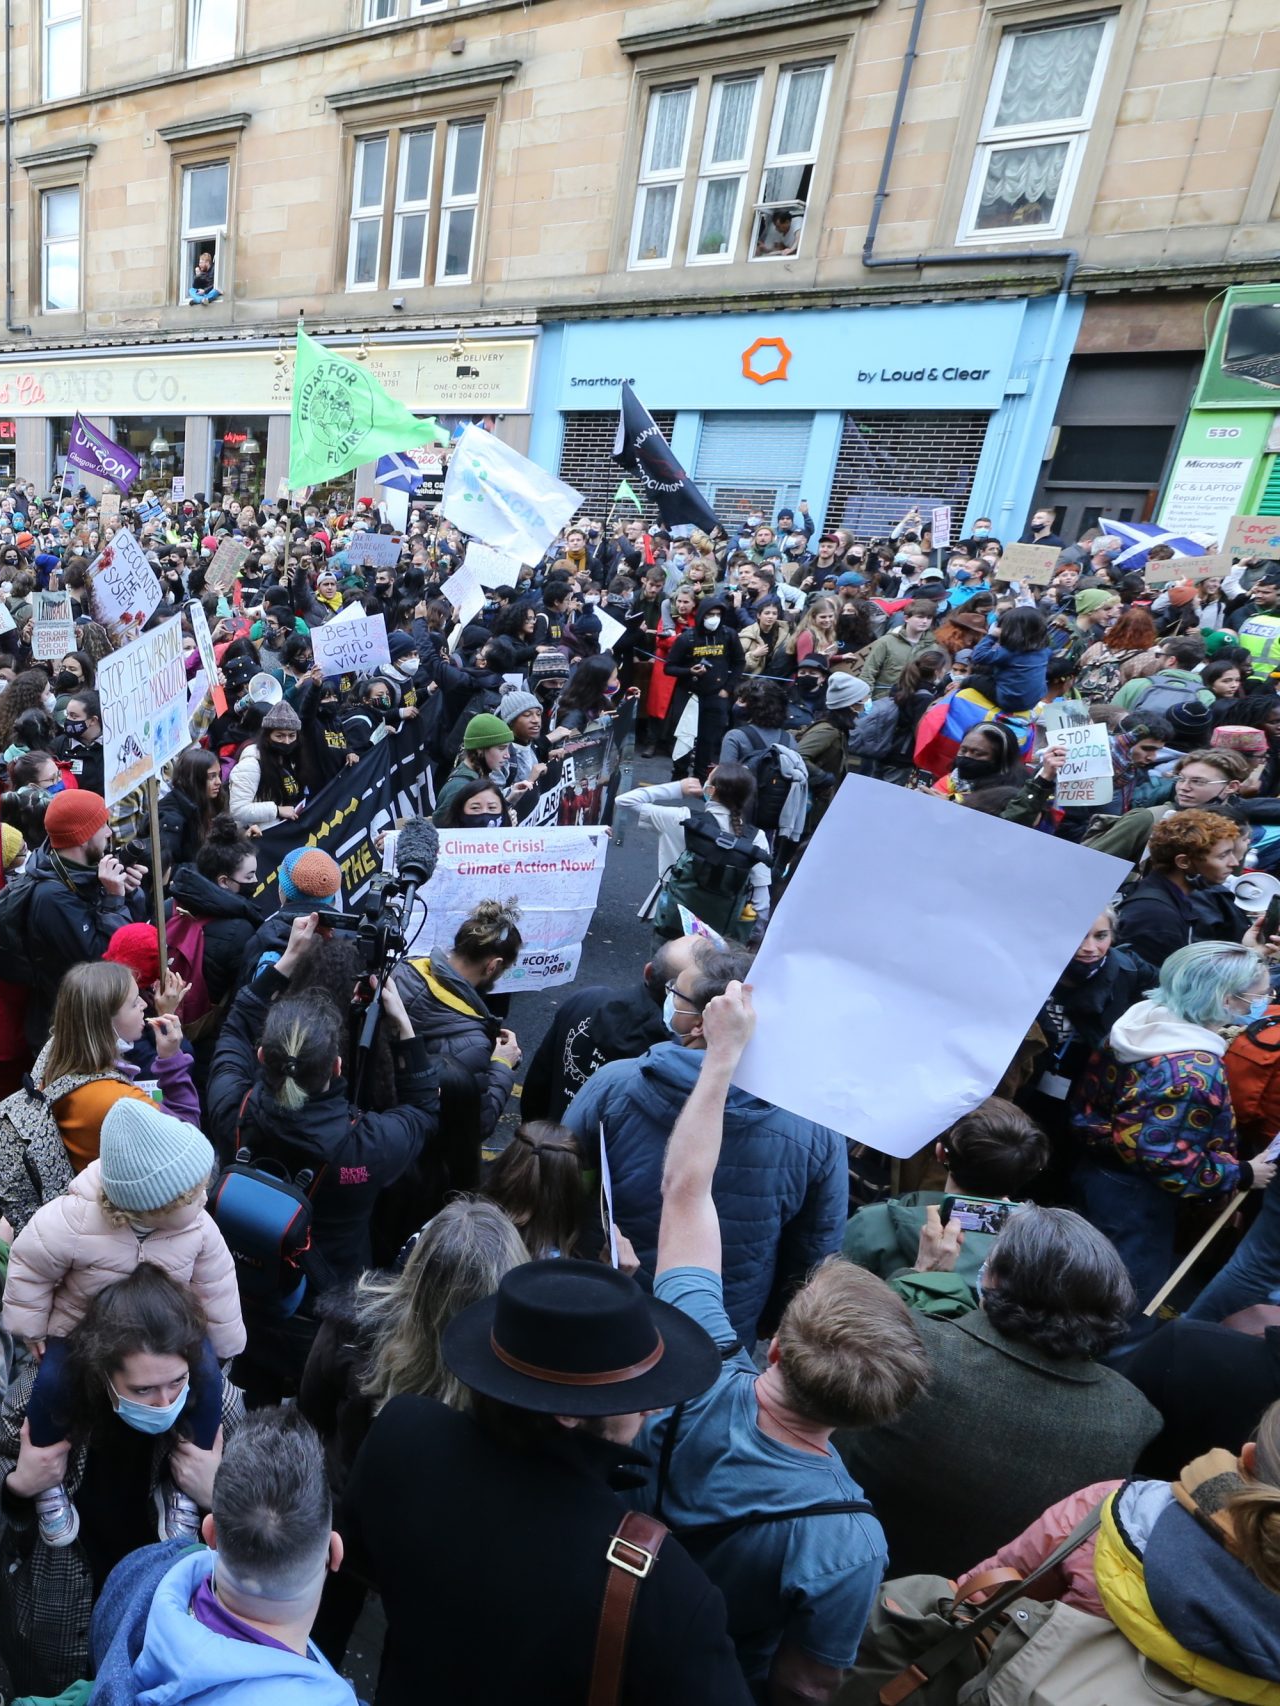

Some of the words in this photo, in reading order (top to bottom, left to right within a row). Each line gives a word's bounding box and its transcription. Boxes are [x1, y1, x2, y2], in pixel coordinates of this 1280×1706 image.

[464, 353, 504, 361] DELIVERY
[328, 362, 358, 387] FOR
[858, 370, 877, 383] by
[881, 368, 925, 382] Loud
[927, 368, 938, 381] &
[942, 367, 990, 381] Clear
[1209, 428, 1240, 438] 530
[69, 452, 97, 473] Glasgow
[1185, 460, 1243, 469] Microsoft
[1174, 483, 1188, 491] PC
[1200, 484, 1242, 492] LAPTOP
[1173, 494, 1202, 503] Repair
[1237, 520, 1277, 535] Love
[115, 533, 160, 607] DECOLONISE
[104, 566, 135, 612] SYSTEM
[123, 571, 142, 595] THE
[321, 621, 368, 641] Bety
[335, 653, 369, 668] vive
[99, 661, 125, 706] STOP
[128, 647, 147, 681] THE
[102, 697, 128, 745] STOP
[131, 679, 150, 721] THE
[1057, 729, 1091, 745] STOP
[1071, 781, 1094, 790] OUR
[445, 840, 497, 855] Climate
[503, 839, 545, 854] Crisis!
[340, 840, 377, 891] THE
[457, 861, 511, 876] Climate
[514, 860, 558, 874] Action
[561, 859, 596, 872] Now!
[522, 953, 560, 966] #COP26
